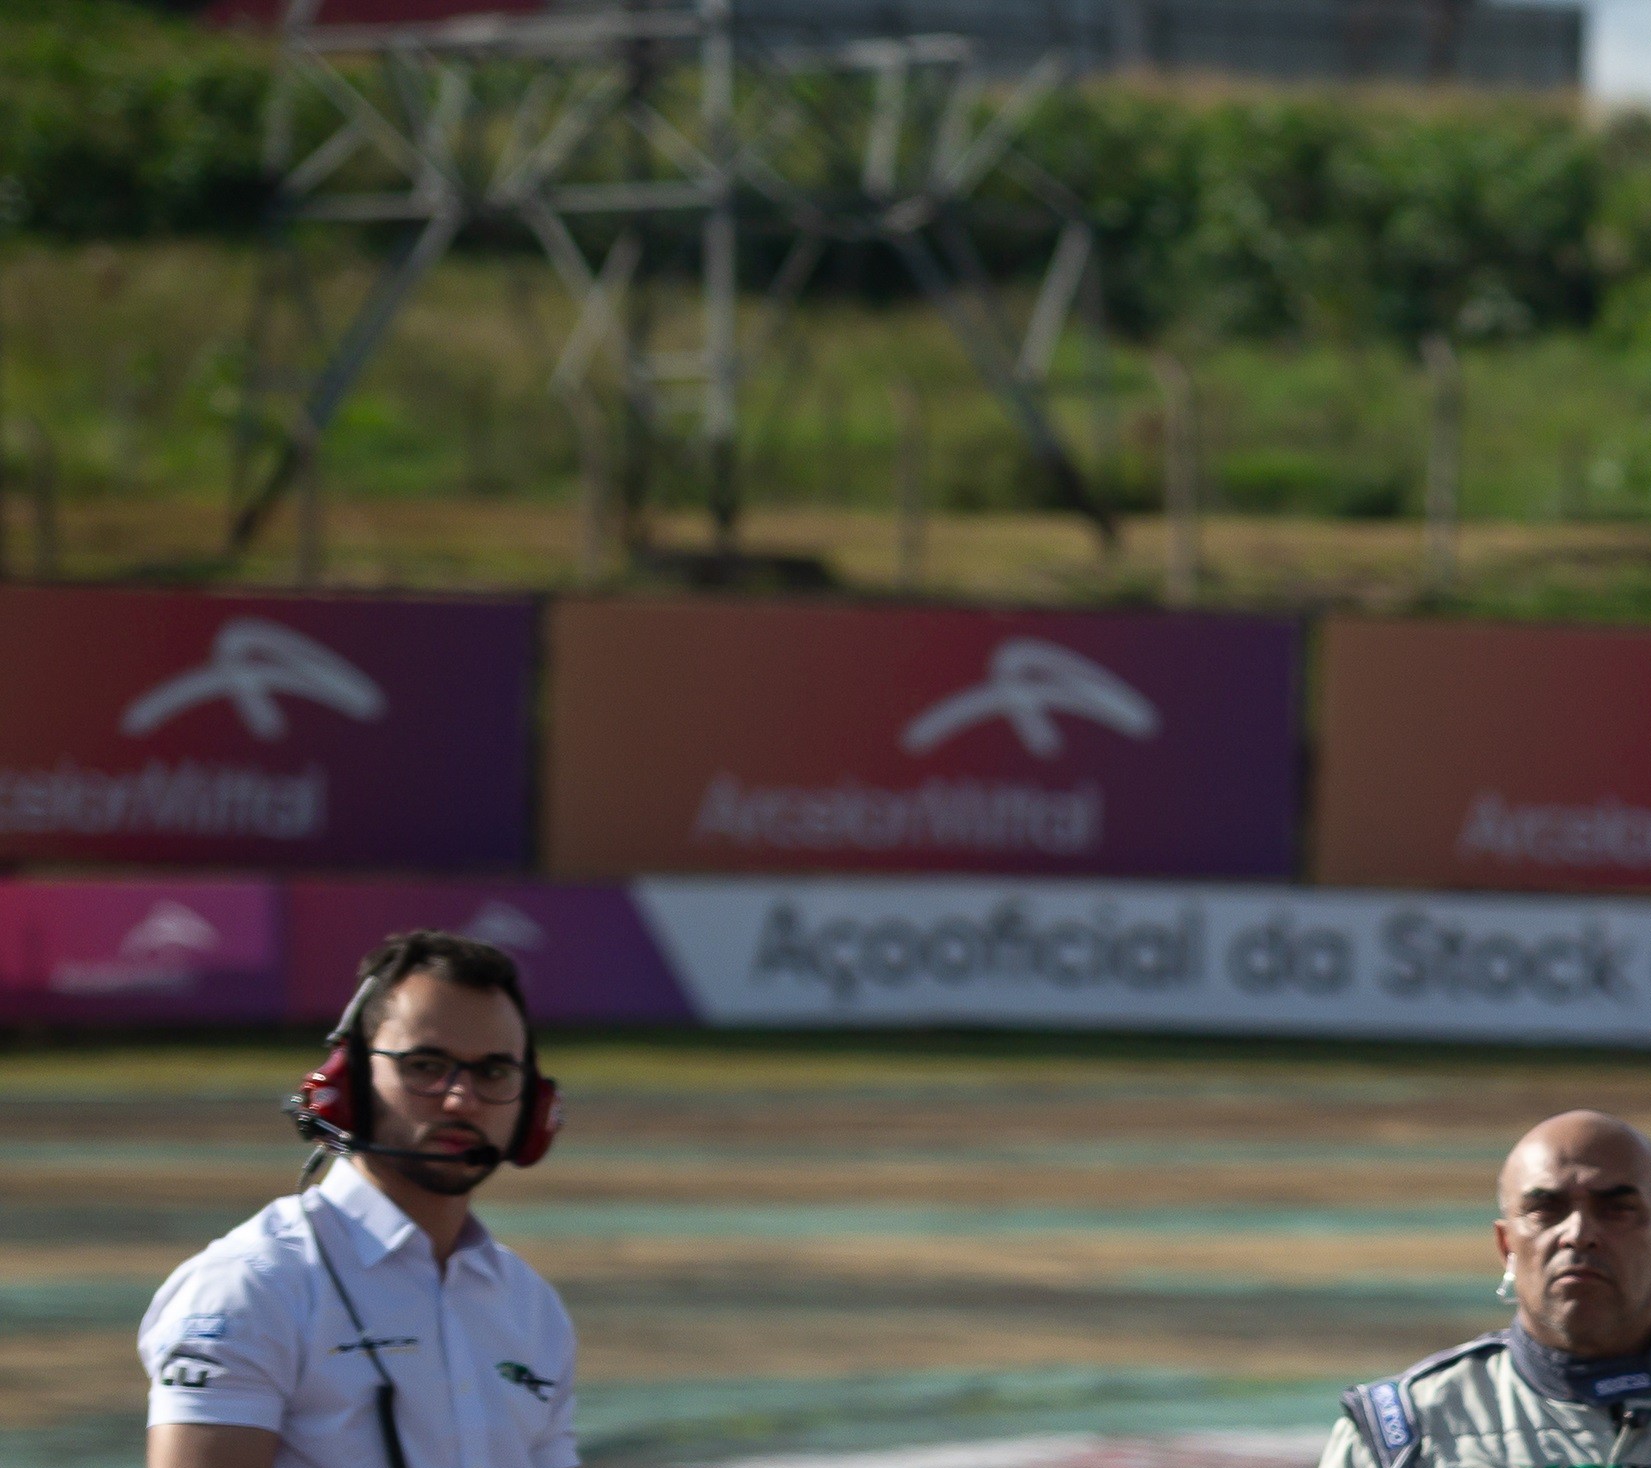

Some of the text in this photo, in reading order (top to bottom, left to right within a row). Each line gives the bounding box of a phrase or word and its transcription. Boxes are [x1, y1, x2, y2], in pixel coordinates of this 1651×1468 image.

[692, 774, 1102, 855] ArcelorMittal
[1226, 912, 1352, 995] da
[1380, 912, 1637, 998] Stock
